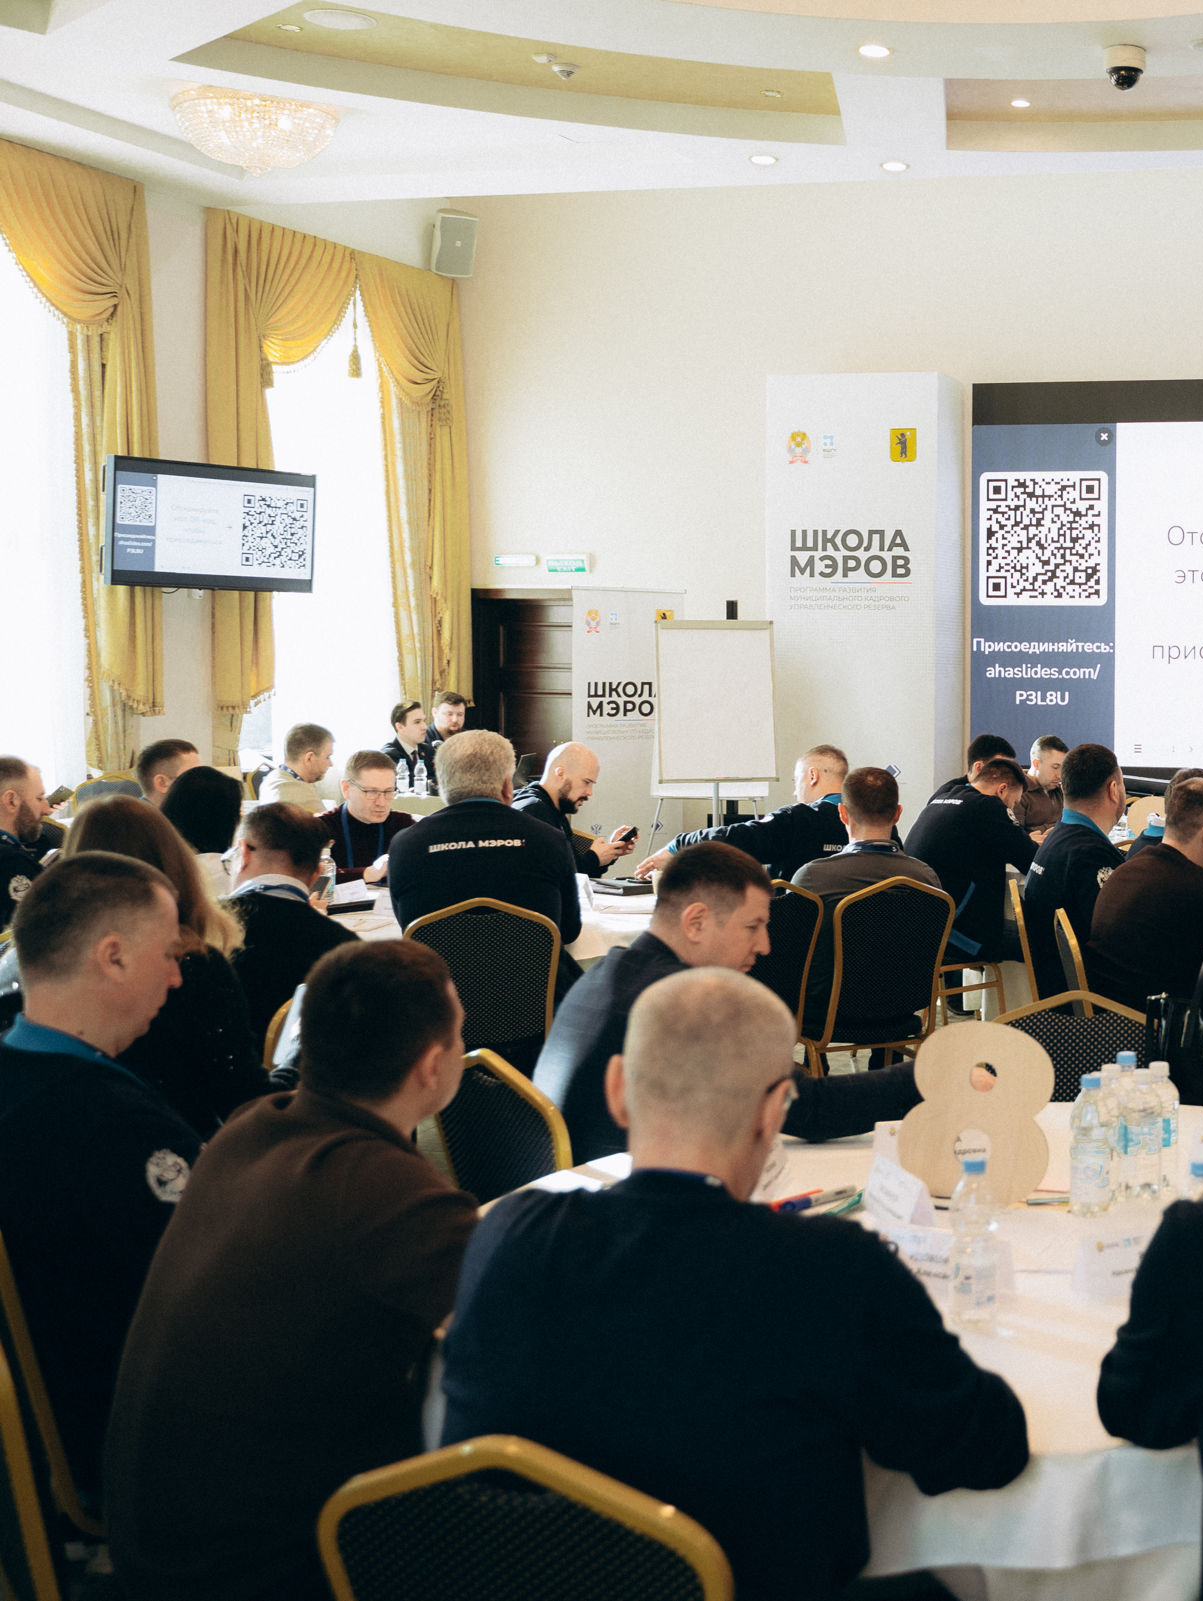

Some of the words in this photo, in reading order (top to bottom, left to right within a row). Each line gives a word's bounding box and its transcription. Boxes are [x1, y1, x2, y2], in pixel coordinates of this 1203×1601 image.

[790, 529, 910, 552] ШКОЛА
[790, 554, 911, 579] МЭРОВ
[972, 638, 1114, 655] Присоединяйтесь:
[986, 664, 1101, 679] ahaslides.com/
[587, 681, 656, 698] ШКОЛ
[1015, 690, 1070, 705] P3L8U
[586, 700, 654, 717] МЭРО
[428, 841, 475, 853] ШКОЛА
